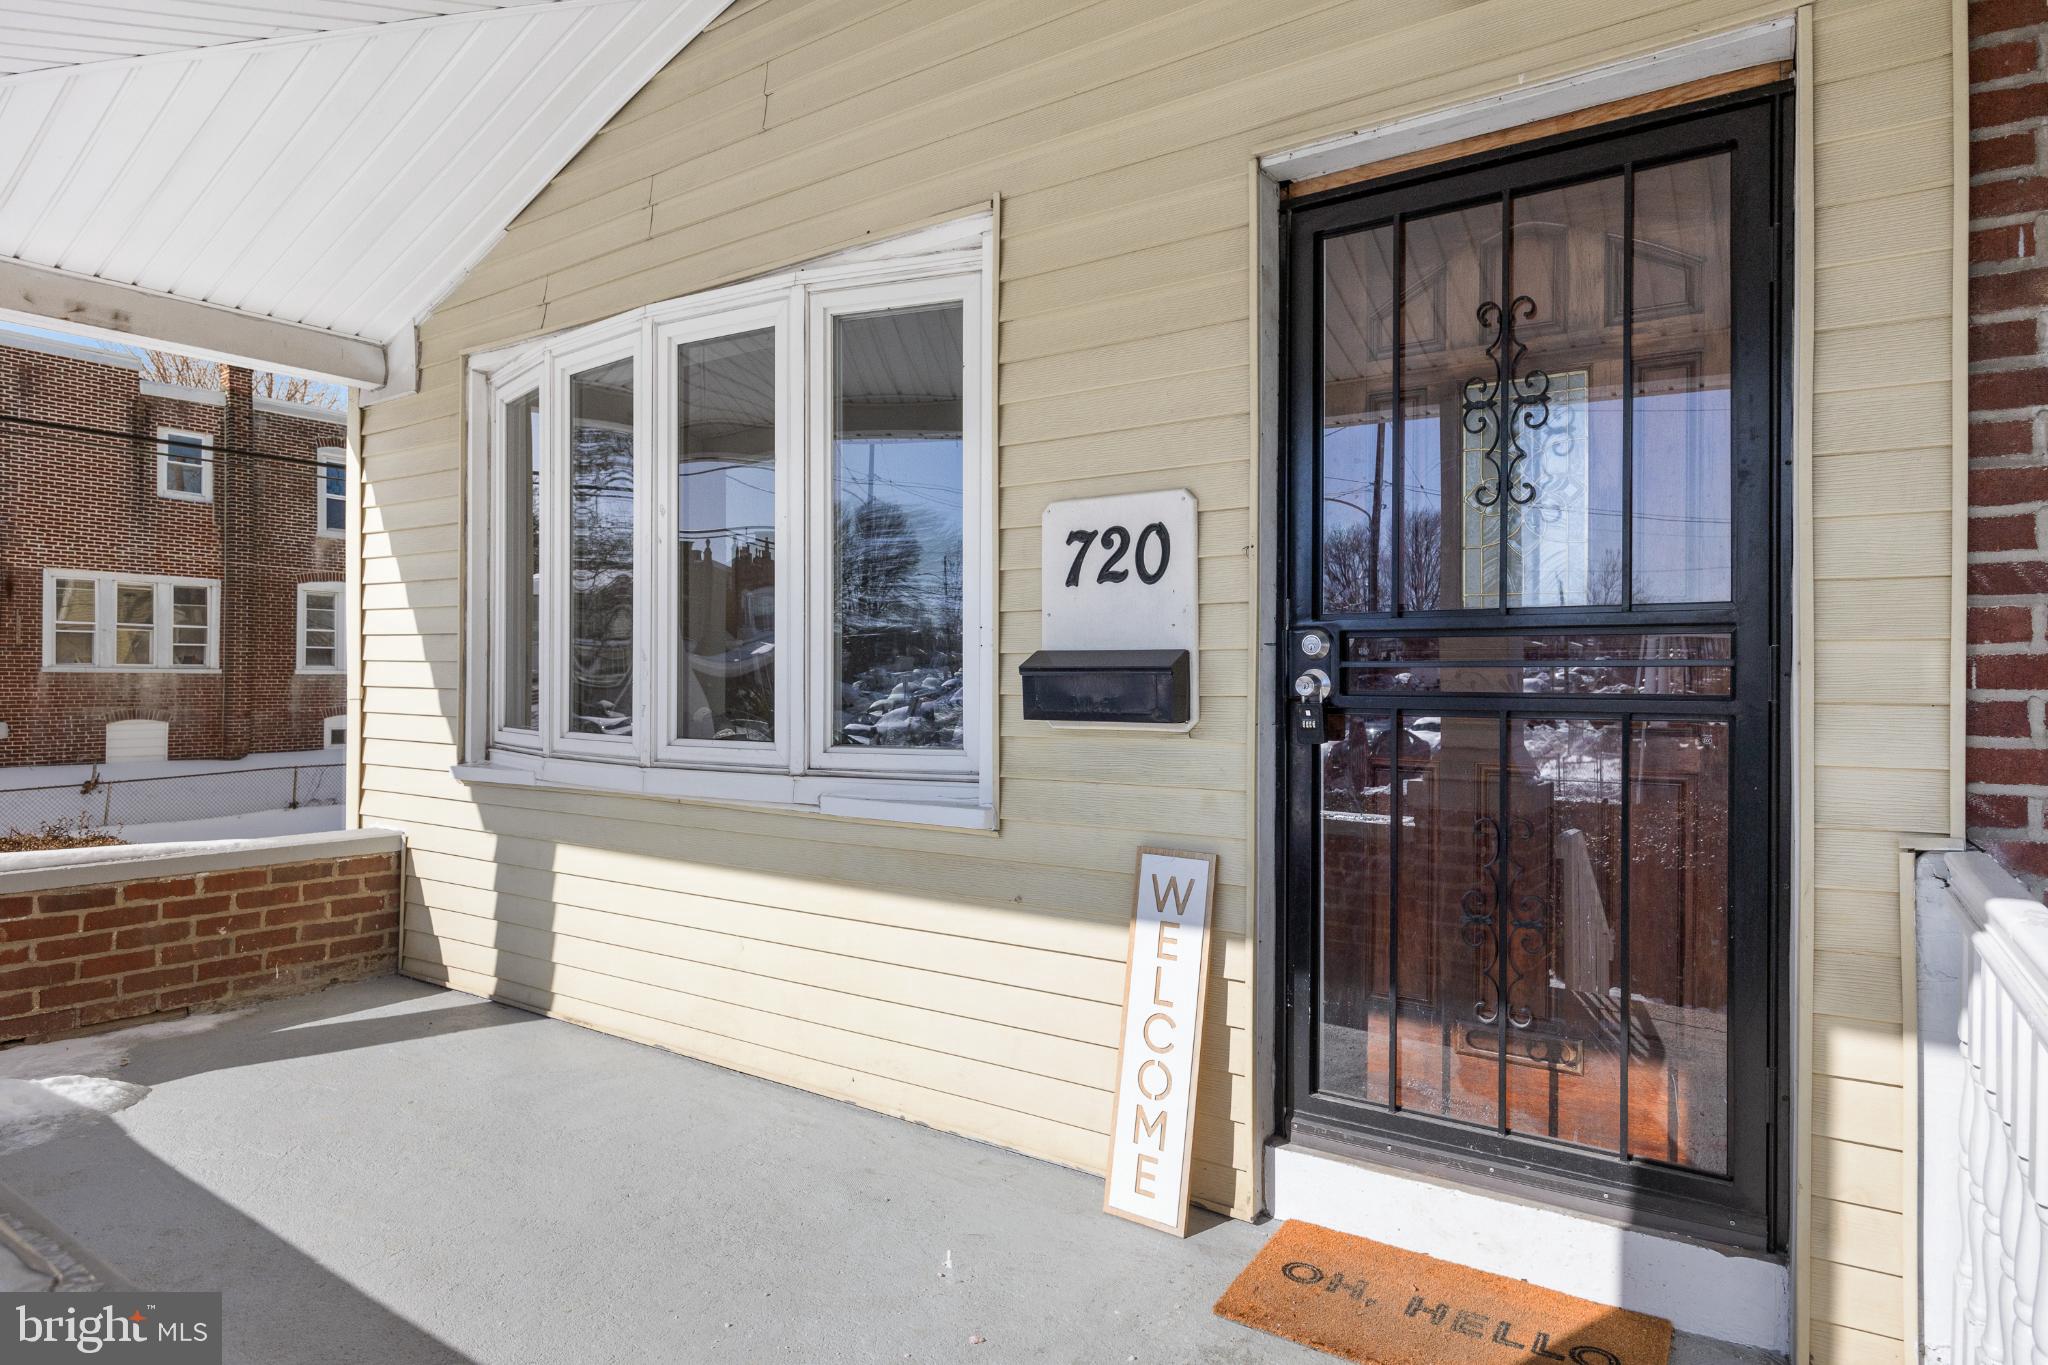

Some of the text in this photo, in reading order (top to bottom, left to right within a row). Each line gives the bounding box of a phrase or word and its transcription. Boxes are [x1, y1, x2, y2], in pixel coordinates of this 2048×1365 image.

[1065, 521, 1171, 588] 720
[1133, 873, 1196, 1200] WELCOME
[1404, 1296, 1621, 1365] HELLO
